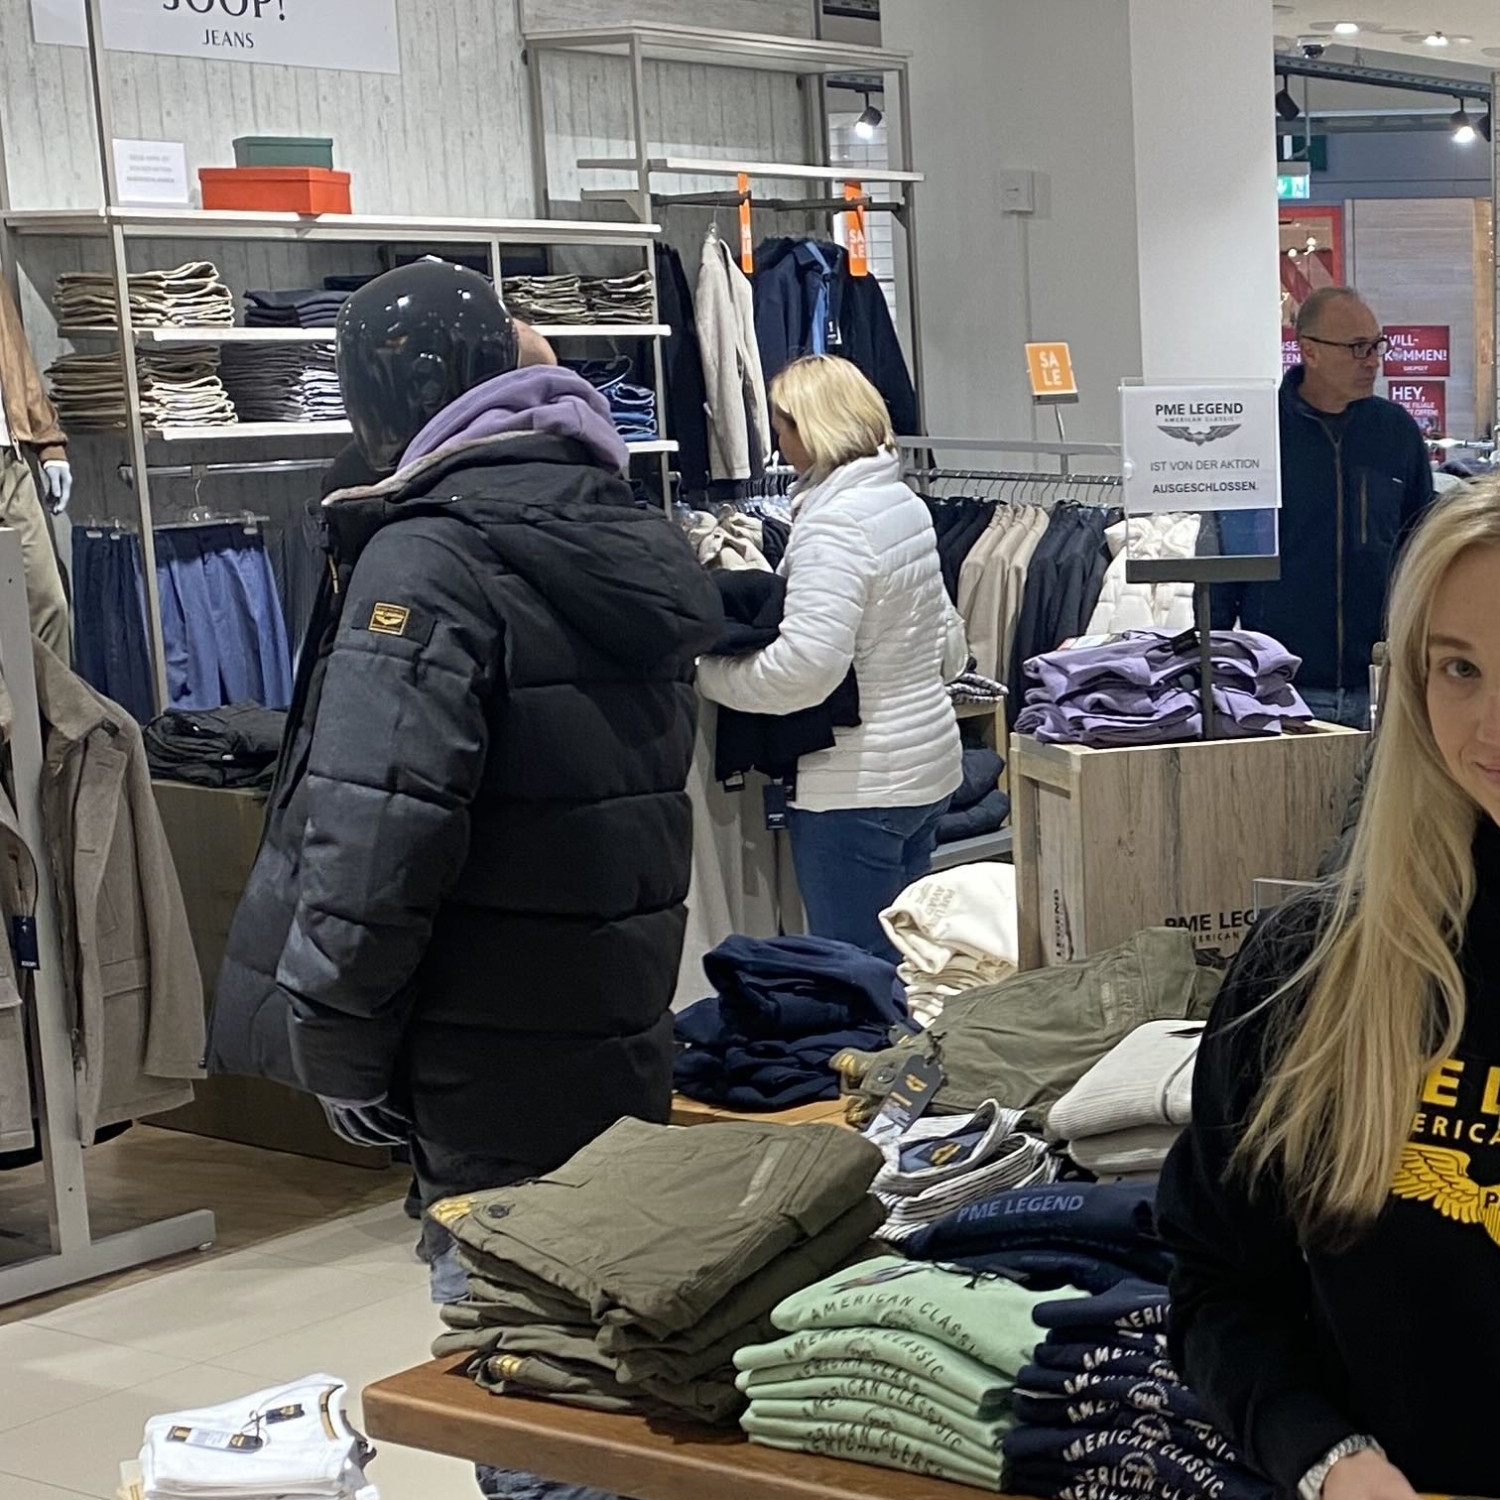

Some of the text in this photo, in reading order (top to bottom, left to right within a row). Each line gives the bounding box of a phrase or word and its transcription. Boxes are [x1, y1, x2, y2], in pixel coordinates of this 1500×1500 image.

[202, 28, 255, 49] JEANS
[1039, 351, 1060, 368] SA
[1043, 370, 1063, 385] LE
[1392, 386, 1426, 402] HEY,
[1155, 402, 1243, 416] PME LEGEND
[1150, 458, 1260, 471] IST VON DER AKTION
[1152, 480, 1259, 493] AUSGESCHLOSSEN.
[1192, 931, 1240, 944] ERICAN
[956, 1194, 1085, 1224] PME LEGEND
[810, 1292, 914, 1323] AMERICAN
[1158, 1442, 1225, 1499] CLASSIC
